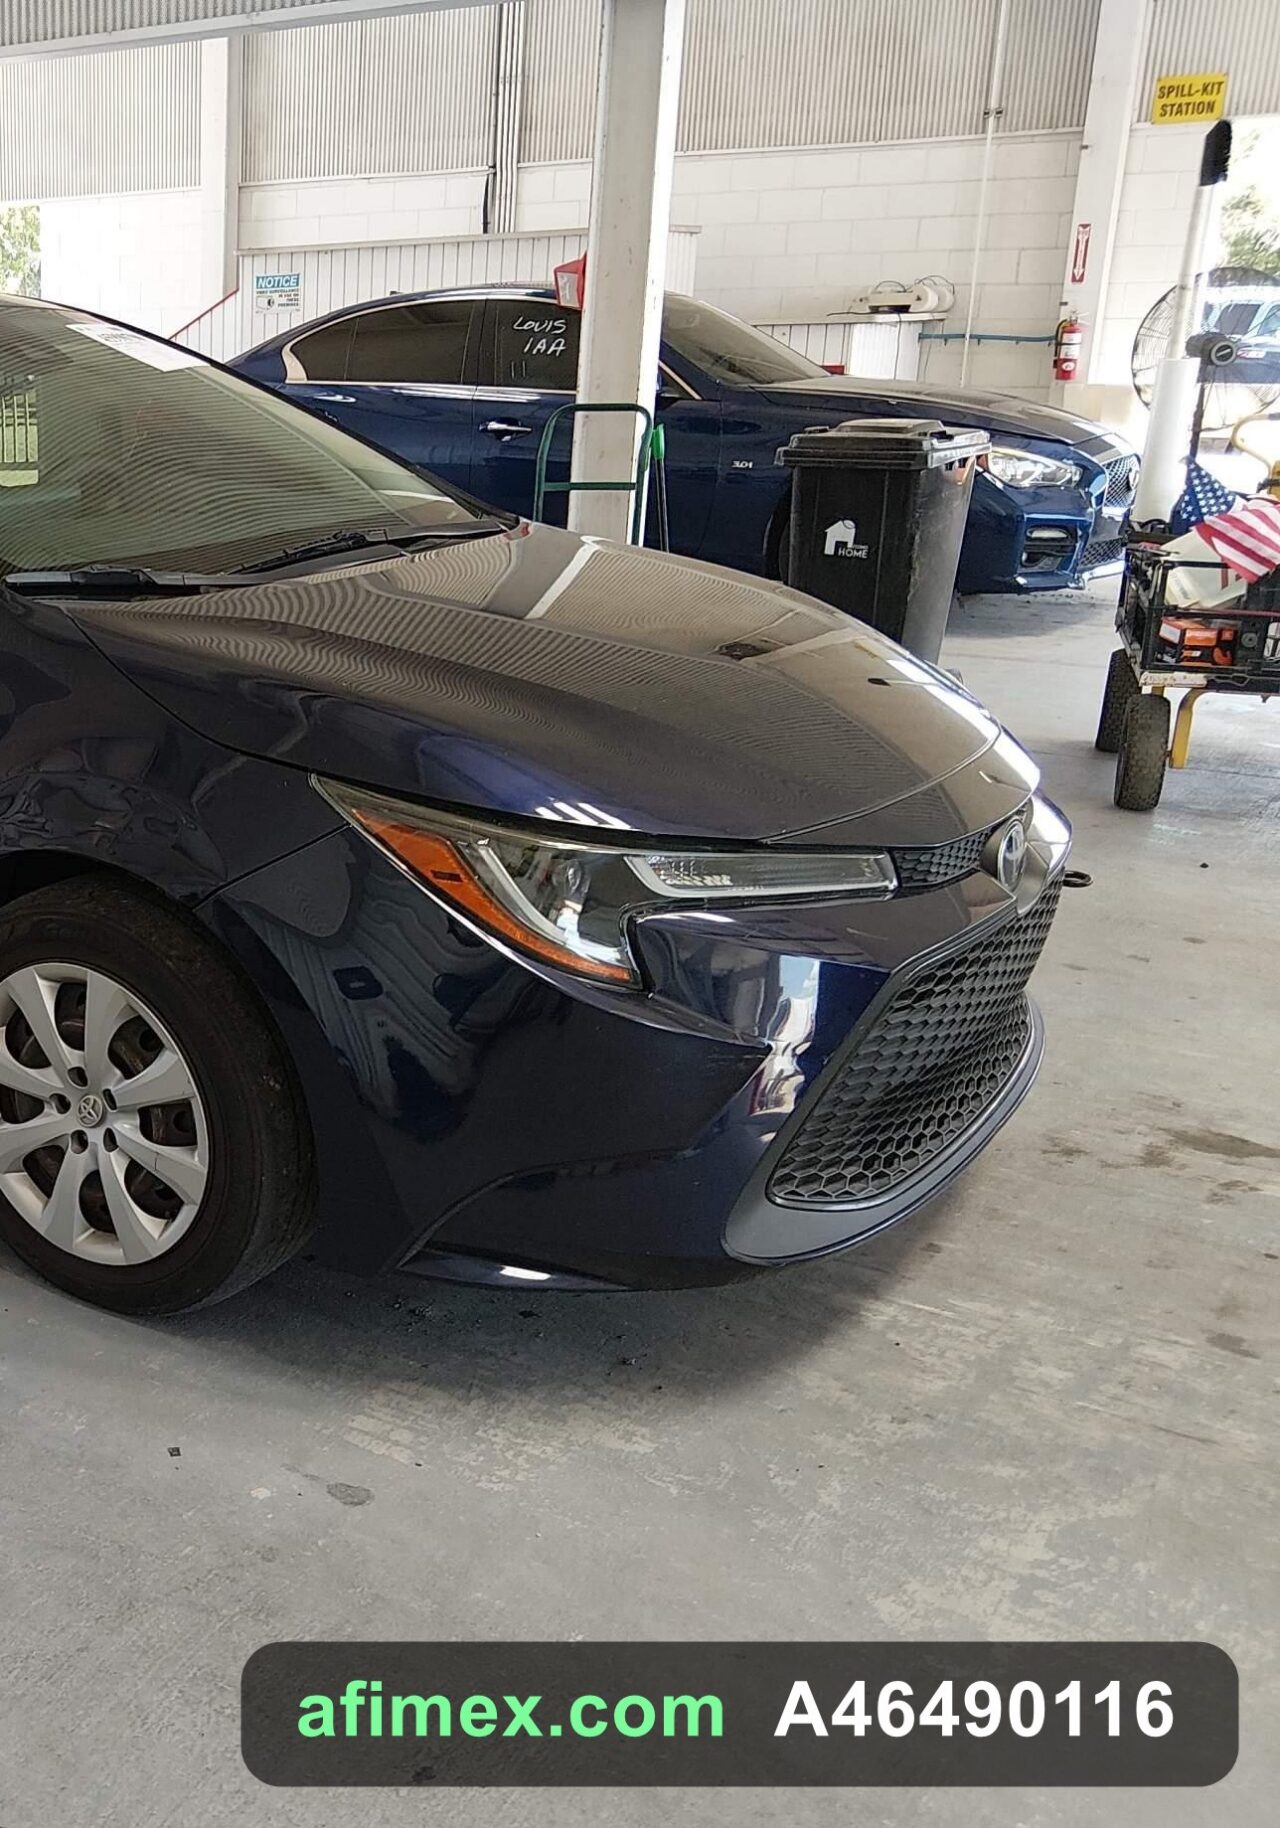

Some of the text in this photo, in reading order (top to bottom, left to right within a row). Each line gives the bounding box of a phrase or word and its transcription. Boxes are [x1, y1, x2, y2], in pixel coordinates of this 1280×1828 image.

[1158, 81, 1225, 99] SPILL-KIT
[1160, 99, 1217, 117] STATION
[257, 275, 298, 288] NOTICE
[513, 316, 567, 334] LOUIS
[838, 547, 869, 559] HOME
